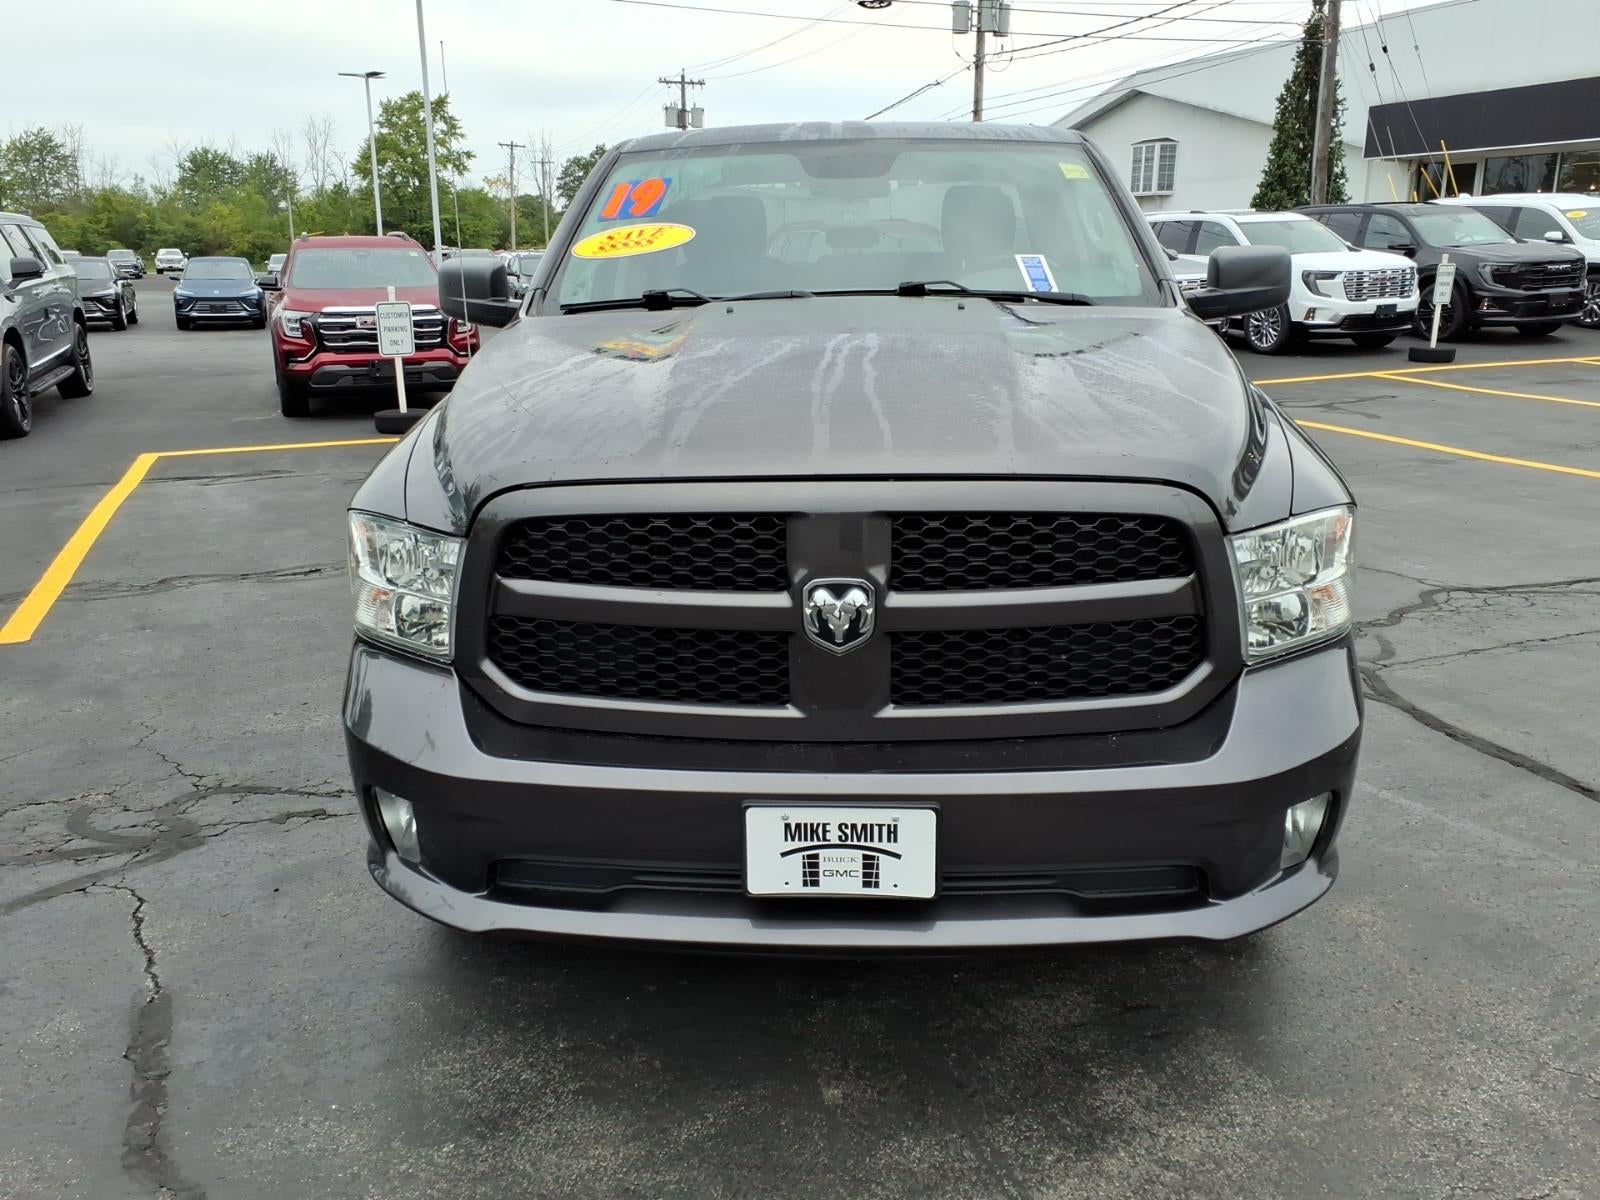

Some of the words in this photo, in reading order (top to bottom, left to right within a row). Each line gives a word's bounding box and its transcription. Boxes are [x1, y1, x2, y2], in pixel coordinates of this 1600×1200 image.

[601, 177, 666, 219] 19
[380, 312, 408, 320] CUSTOMER
[383, 325, 408, 333] PARKING
[783, 822, 832, 843] MIKE
[837, 823, 899, 844] SMITH
[823, 856, 859, 864] BUICK
[822, 869, 860, 878] GMC
